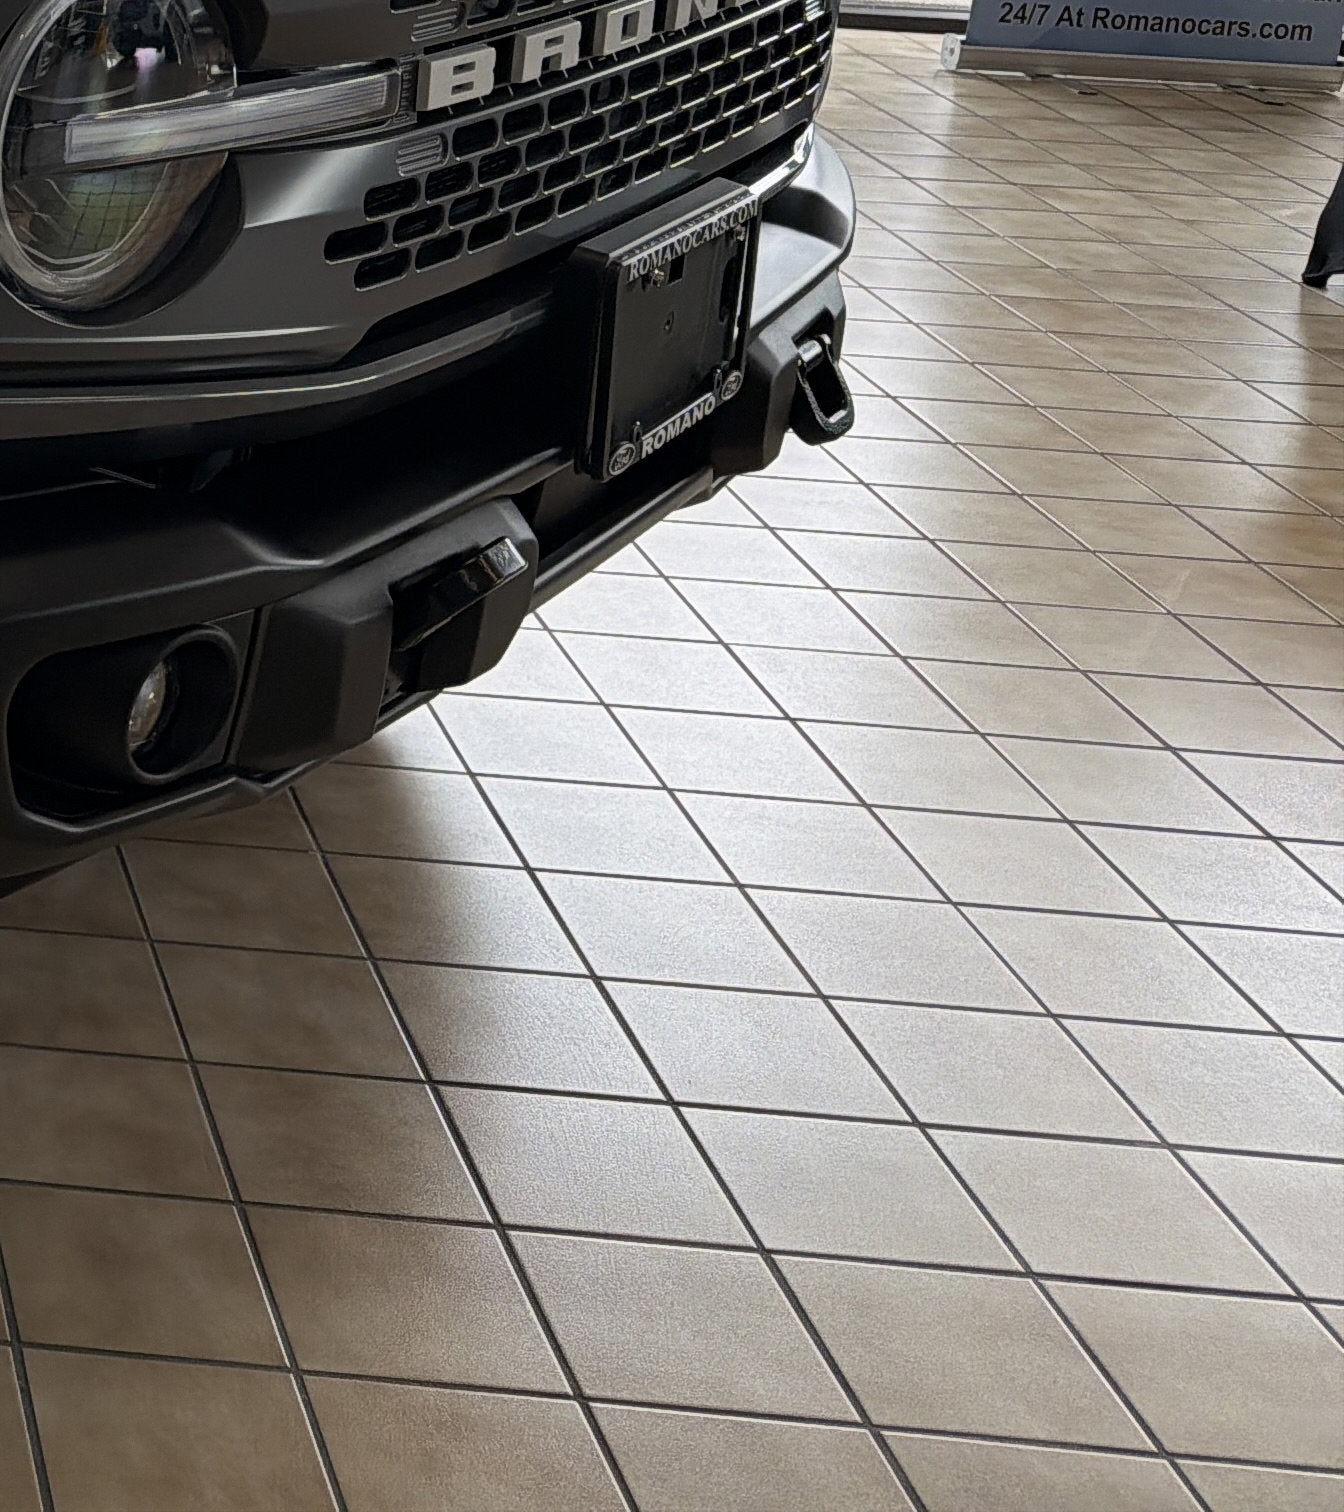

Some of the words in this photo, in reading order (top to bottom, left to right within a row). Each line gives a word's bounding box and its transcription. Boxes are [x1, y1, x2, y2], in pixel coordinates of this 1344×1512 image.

[999, 2, 1051, 26] 24/7
[1055, 5, 1085, 28] At
[1092, 8, 1313, 42] Romanocars.com
[627, 199, 758, 282] ROMANOCARS.COM
[641, 395, 716, 459] ROMANO
